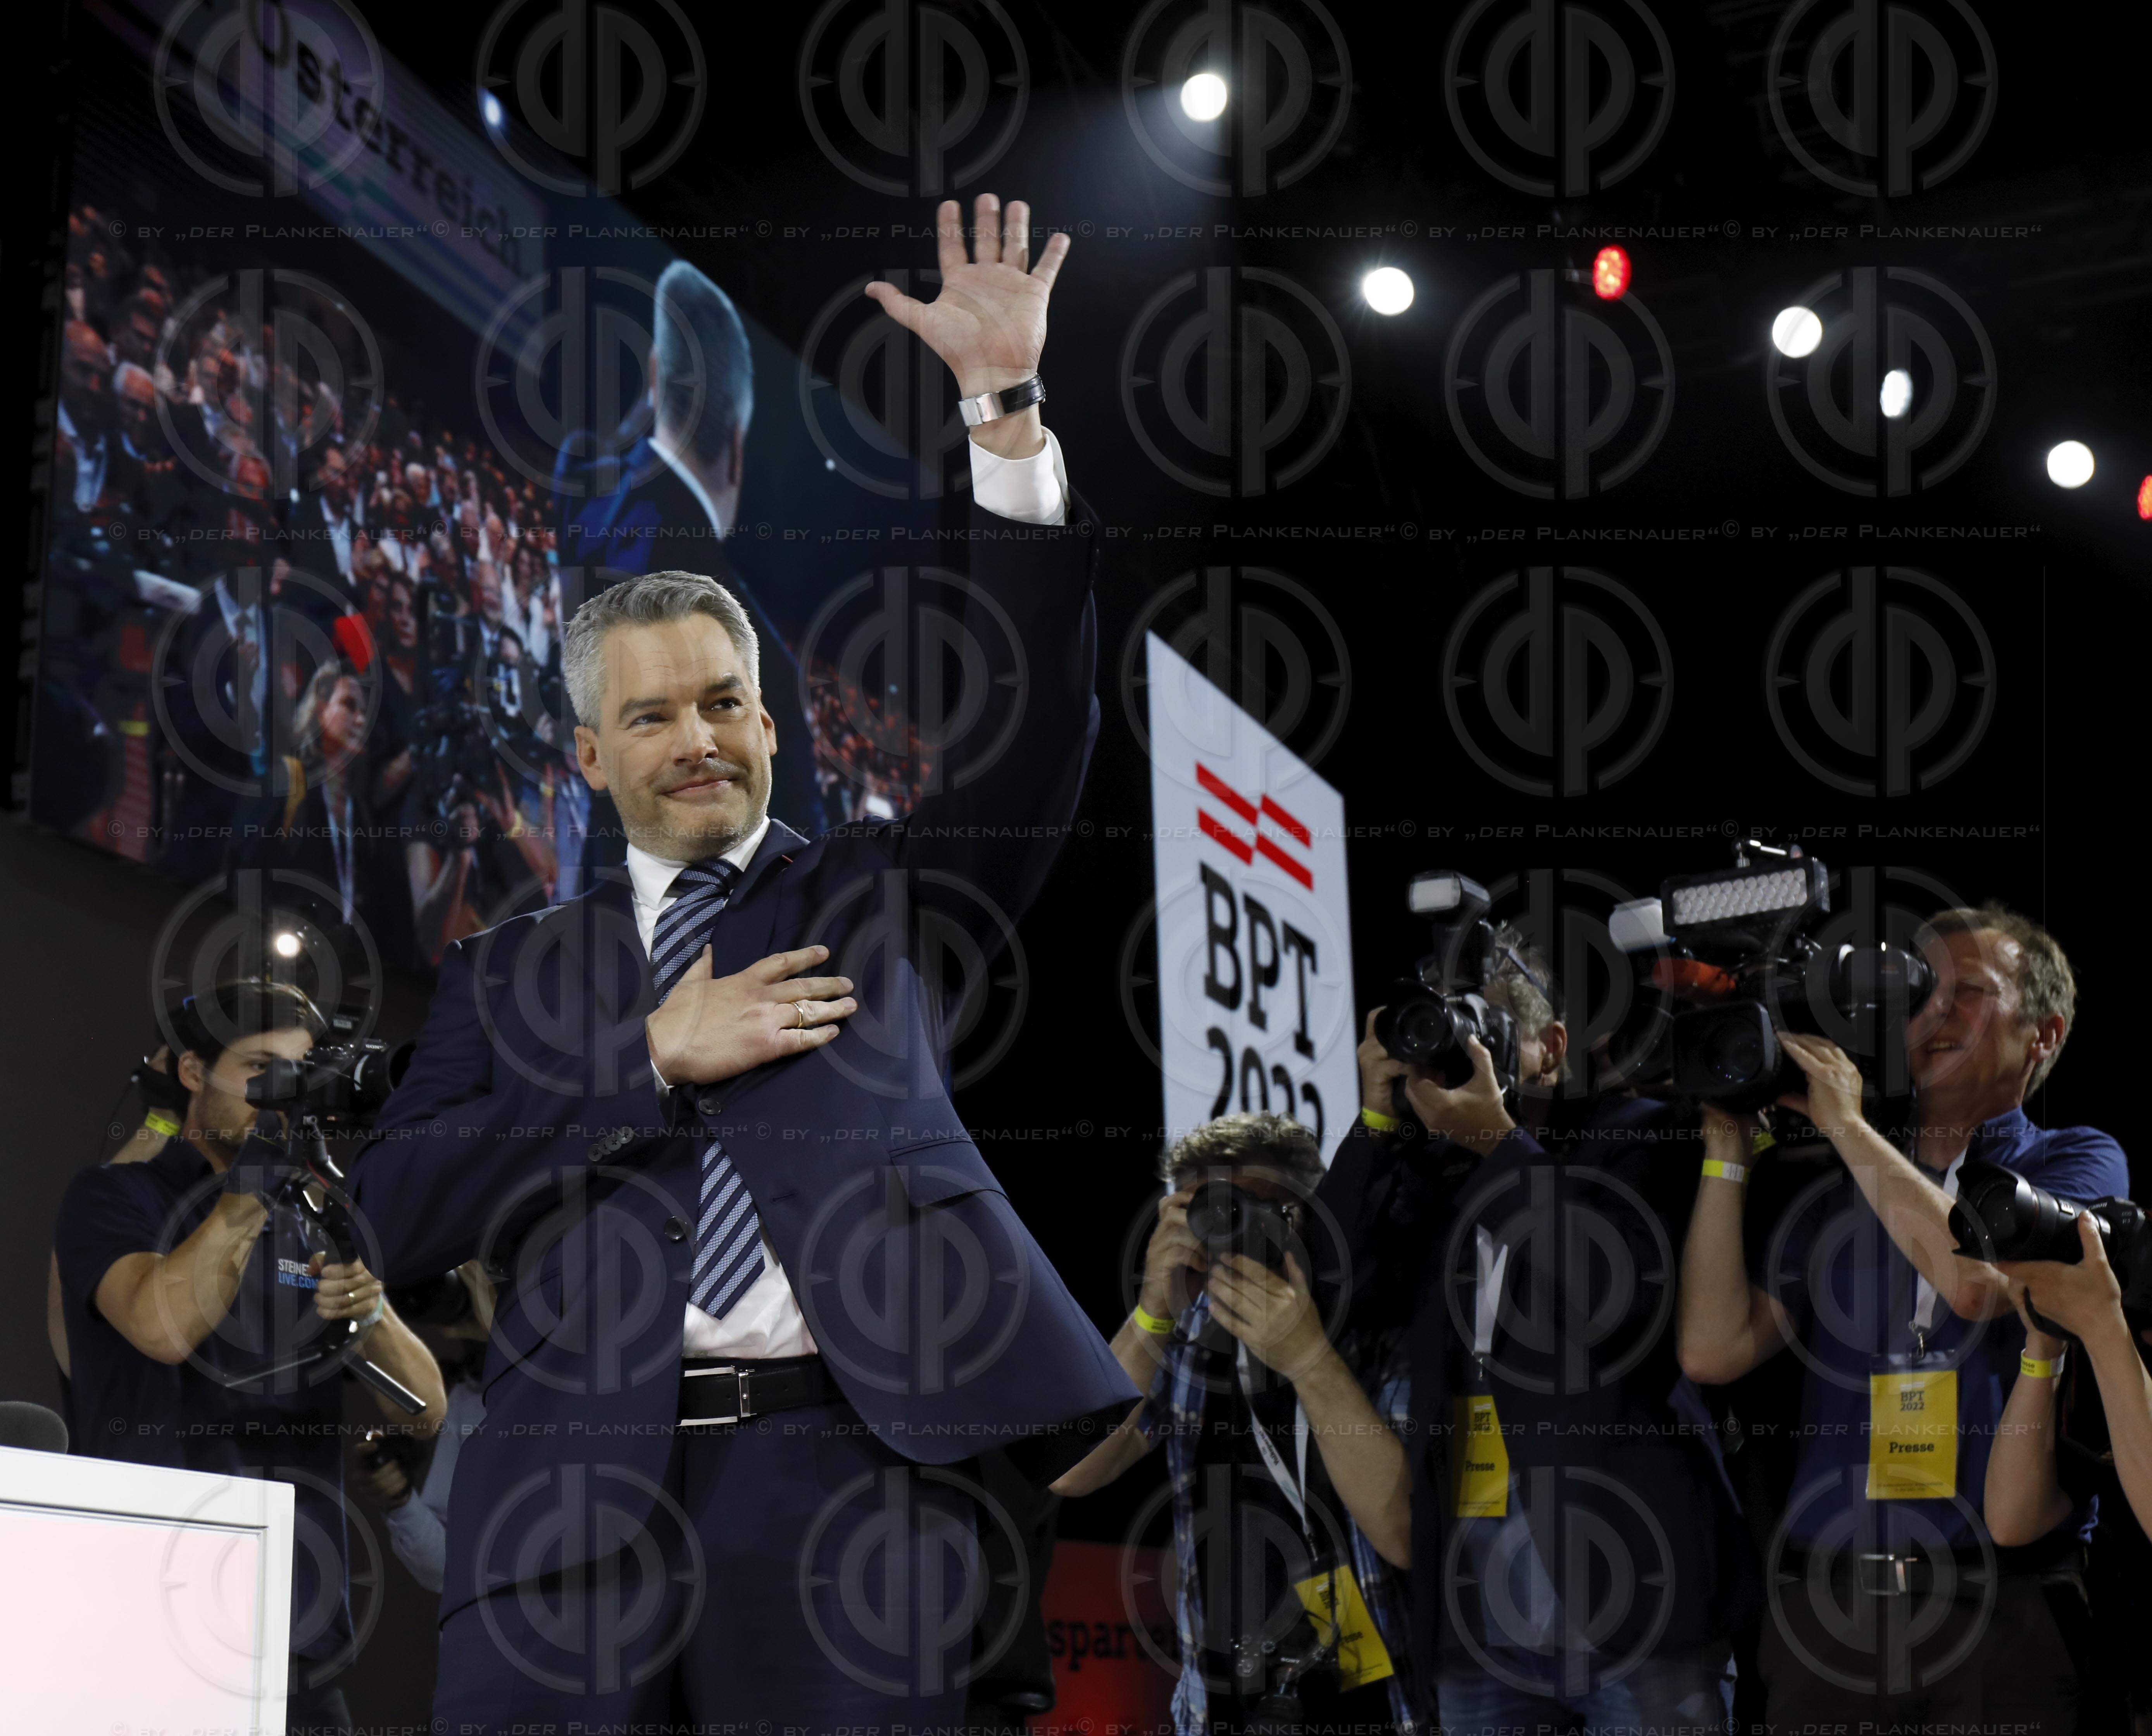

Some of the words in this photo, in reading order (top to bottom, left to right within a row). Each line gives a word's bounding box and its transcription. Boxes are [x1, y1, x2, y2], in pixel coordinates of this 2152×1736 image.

[1200, 861, 1317, 1061] BPT
[278, 1258, 312, 1277] STEINE
[1901, 1390, 1924, 1402] BPT
[1889, 1442, 1935, 1453] Presse
[1465, 1460, 1495, 1471] Presse
